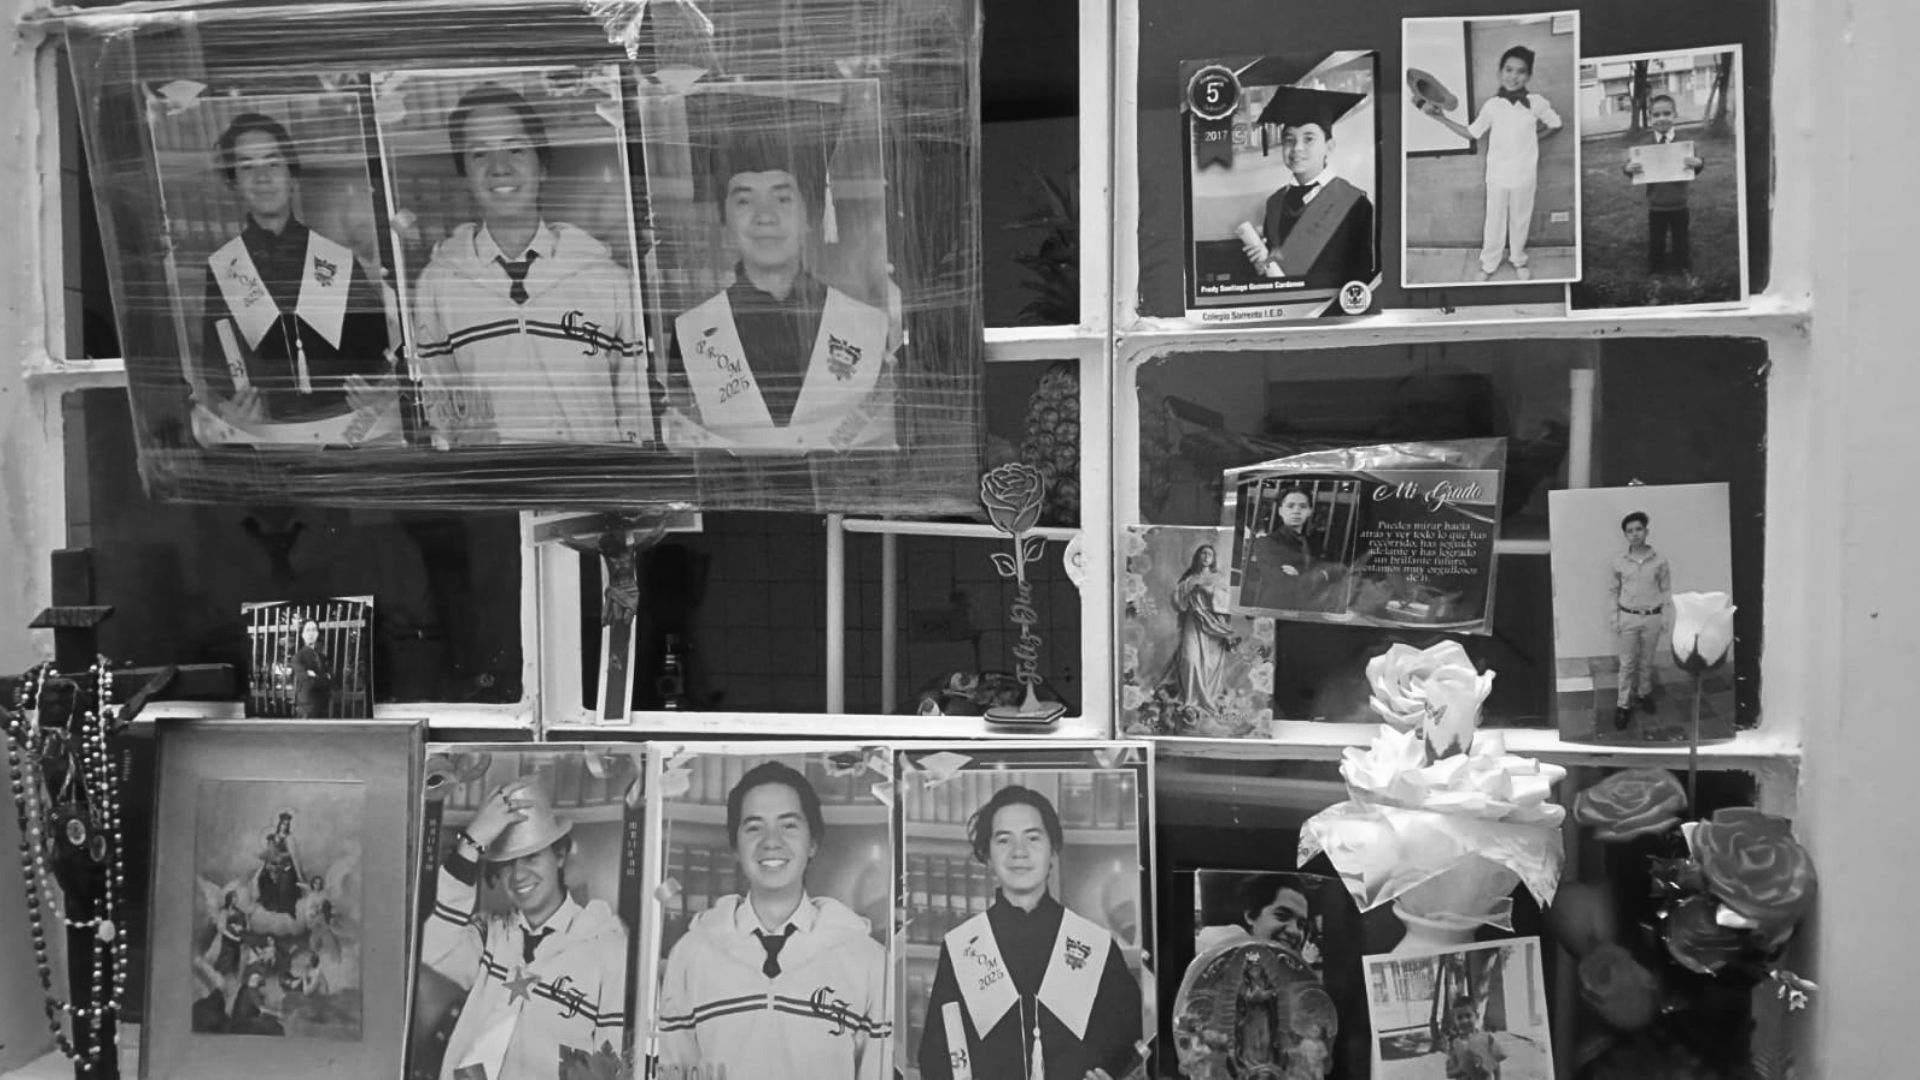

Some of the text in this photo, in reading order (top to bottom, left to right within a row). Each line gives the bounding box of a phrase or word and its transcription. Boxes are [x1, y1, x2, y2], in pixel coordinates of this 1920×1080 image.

[1204, 130, 1228, 142] 2017
[1202, 312, 1230, 321] Colegio
[1372, 480, 1482, 512] Mi Grado
[1378, 520, 1411, 530] Puedes
[1414, 522, 1442, 530] mirar
[1395, 531, 1411, 539] ver
[1413, 530, 1436, 539] todo
[1449, 531, 1468, 541] que
[1470, 530, 1487, 540] has
